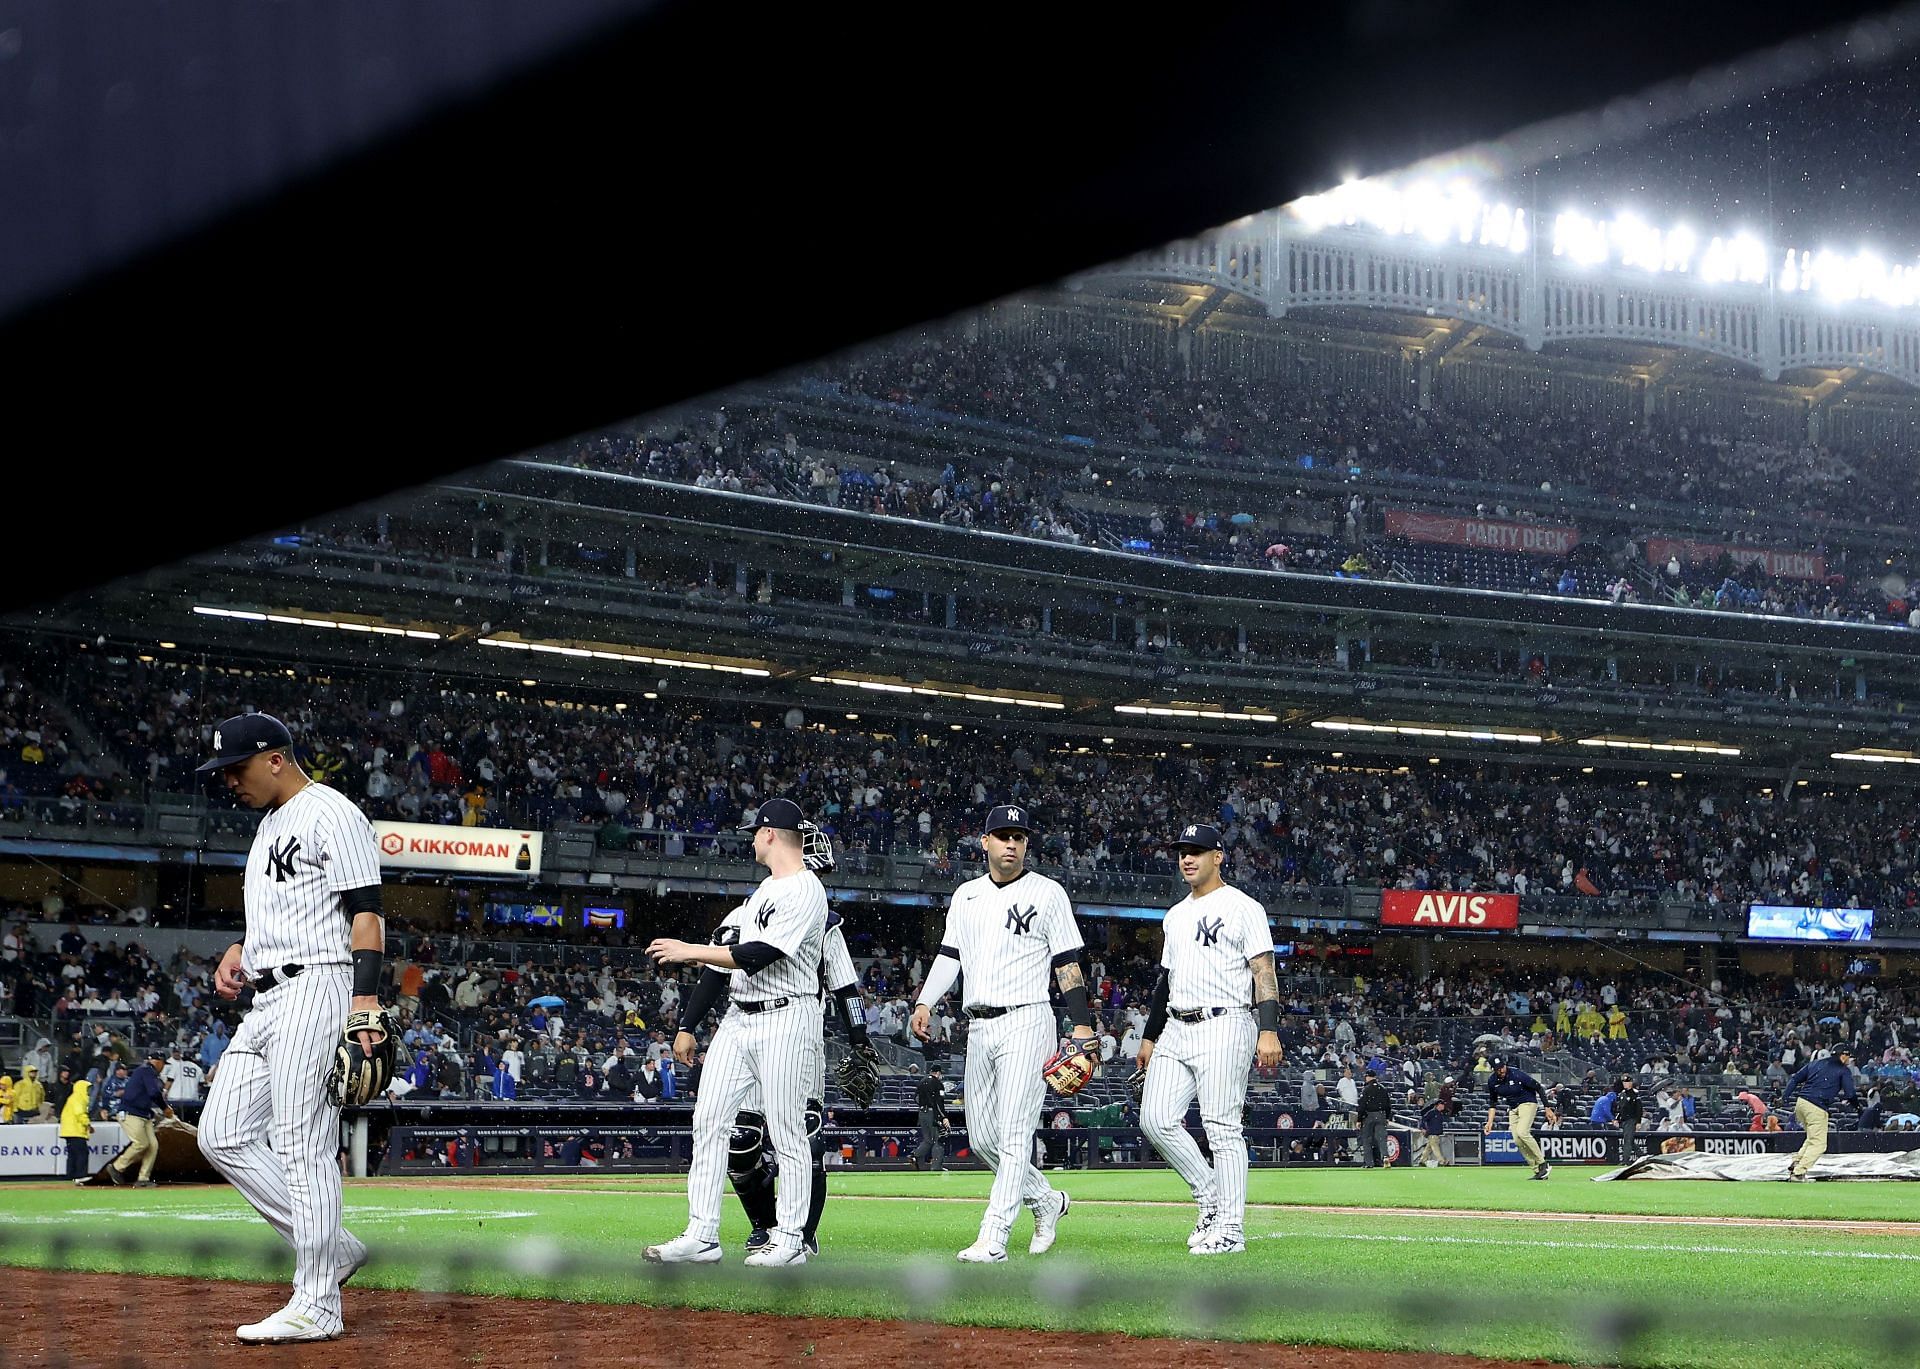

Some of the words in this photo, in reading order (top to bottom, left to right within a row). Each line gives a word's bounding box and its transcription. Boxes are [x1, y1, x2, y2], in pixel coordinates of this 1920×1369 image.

[1466, 521, 1518, 546] PARTY
[1523, 528, 1569, 552] DECK
[1774, 554, 1815, 578] DECK
[750, 615, 776, 626] 1977
[969, 642, 992, 652] 1978
[1355, 680, 1377, 690] 1998
[1007, 808, 1020, 821] NY
[1184, 825, 1198, 837] NY
[410, 838, 509, 858] KIKKOMAN
[264, 835, 302, 883] NY
[755, 898, 776, 932] NY
[1413, 894, 1487, 925] AVIS
[1005, 903, 1038, 936] NY
[1194, 915, 1225, 947] NY
[183, 1066, 197, 1077] 99
[585, 1075, 594, 1087] B
[0, 1145, 45, 1156] BANK
[1485, 1138, 1518, 1153] GEIC
[1540, 1137, 1606, 1158] PREMIO
[1704, 1138, 1766, 1154] PREMIO
